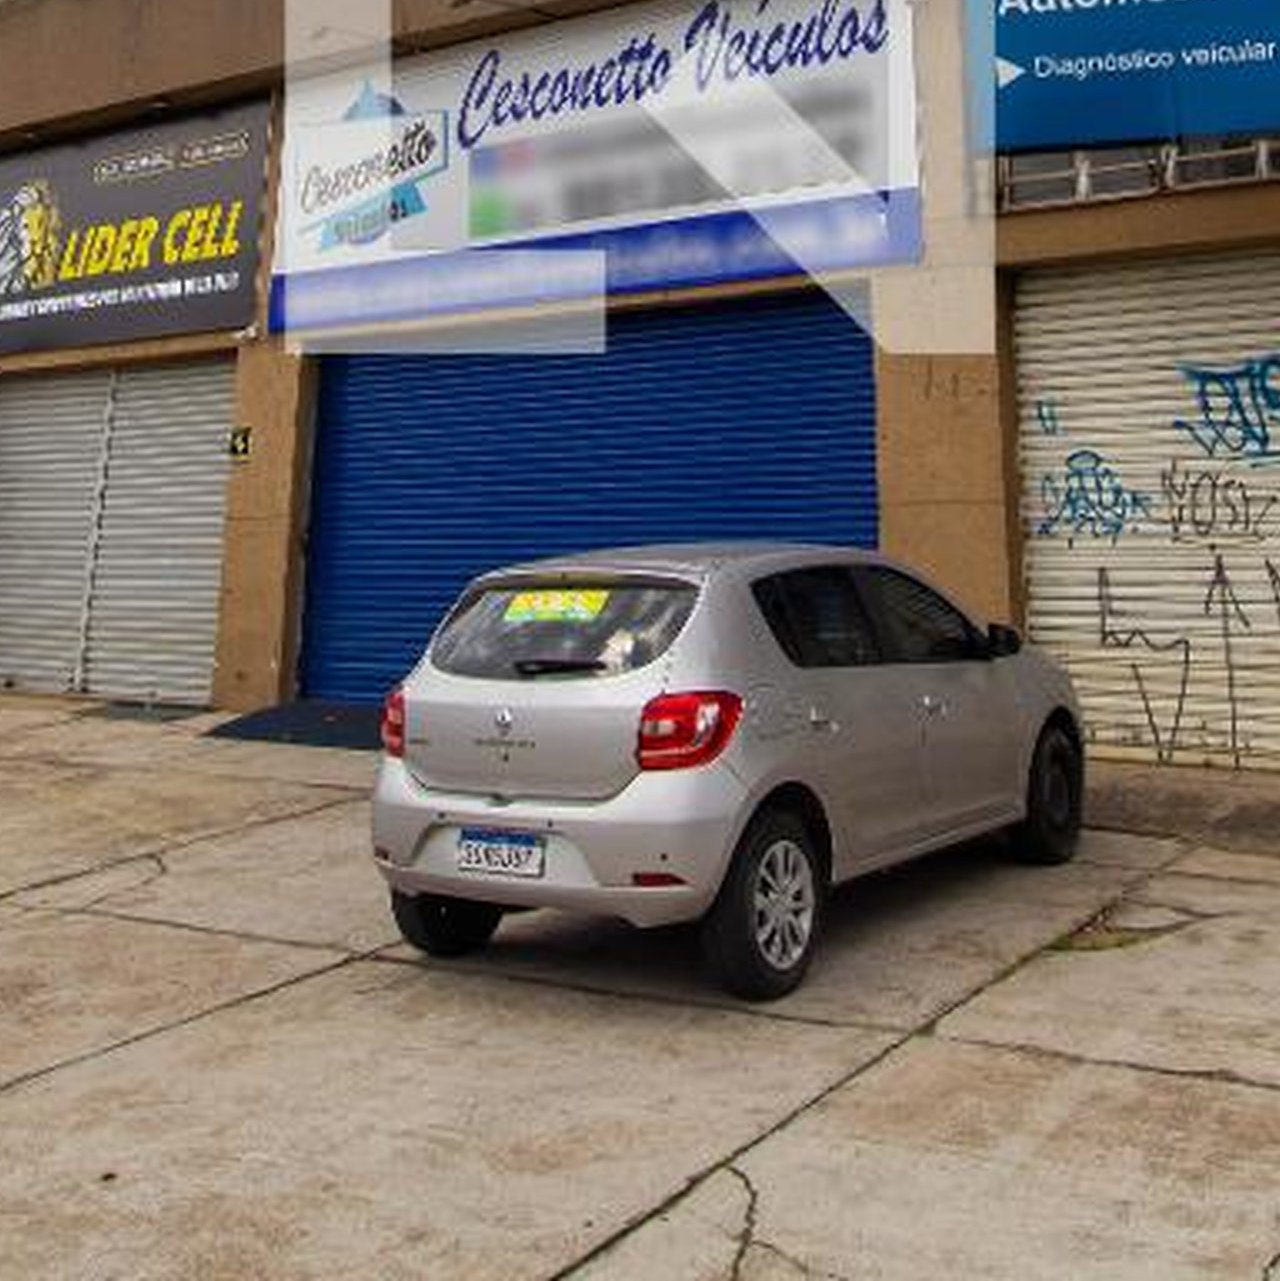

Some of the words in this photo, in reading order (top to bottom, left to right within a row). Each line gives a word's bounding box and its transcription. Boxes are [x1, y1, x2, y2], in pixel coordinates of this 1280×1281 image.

[458, 32, 673, 150] Cesconetto
[1034, 50, 1175, 80] Diagnóstico
[58, 215, 160, 281] LIDER
[163, 200, 245, 265] CELL
